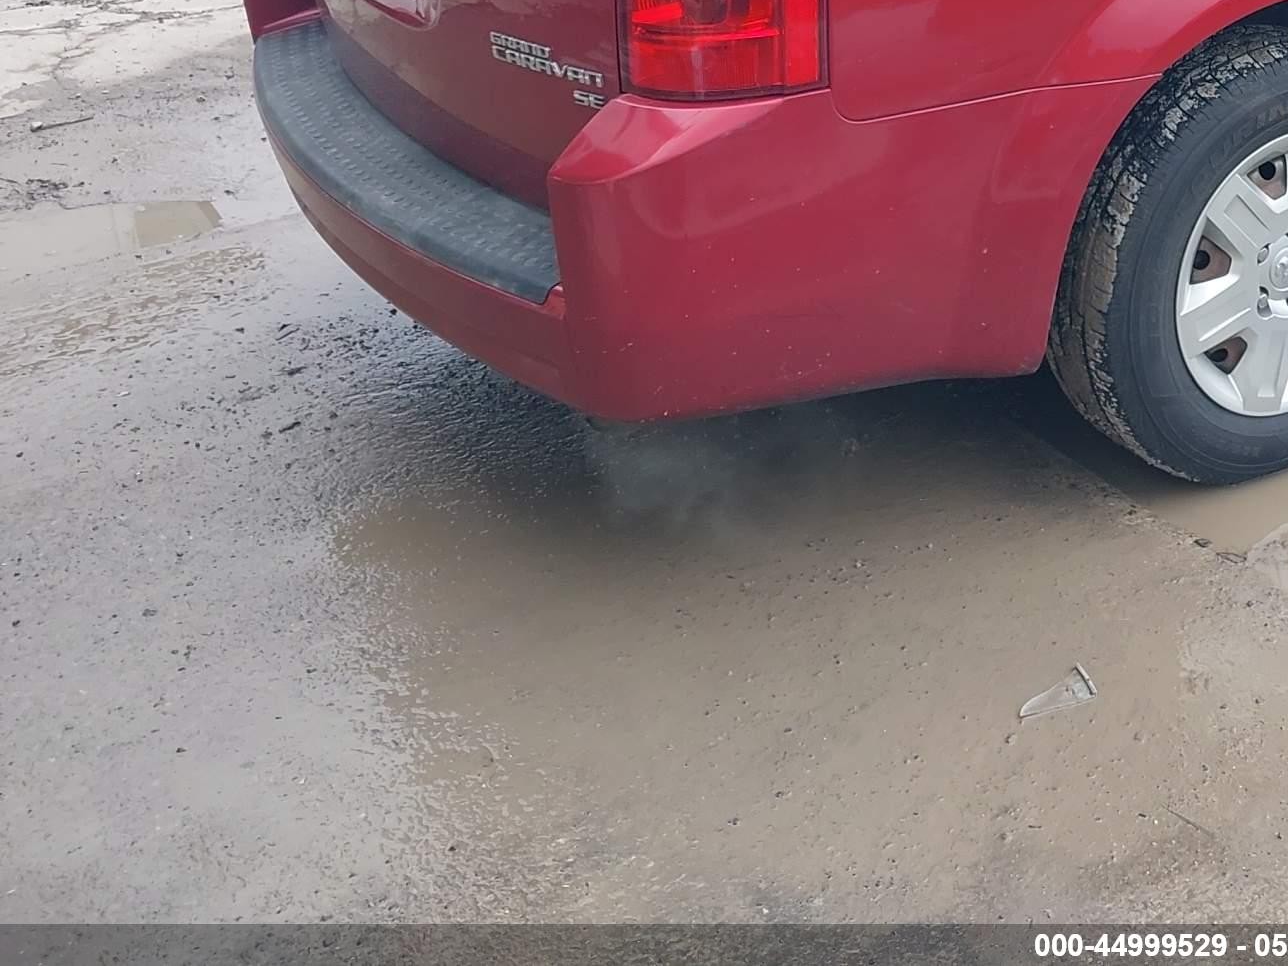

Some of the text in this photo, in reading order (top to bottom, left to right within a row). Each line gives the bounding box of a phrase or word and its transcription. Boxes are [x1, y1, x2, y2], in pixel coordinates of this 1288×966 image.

[490, 31, 551, 58] GRAND
[492, 45, 603, 88] CARAVAN
[573, 90, 604, 109] SE
